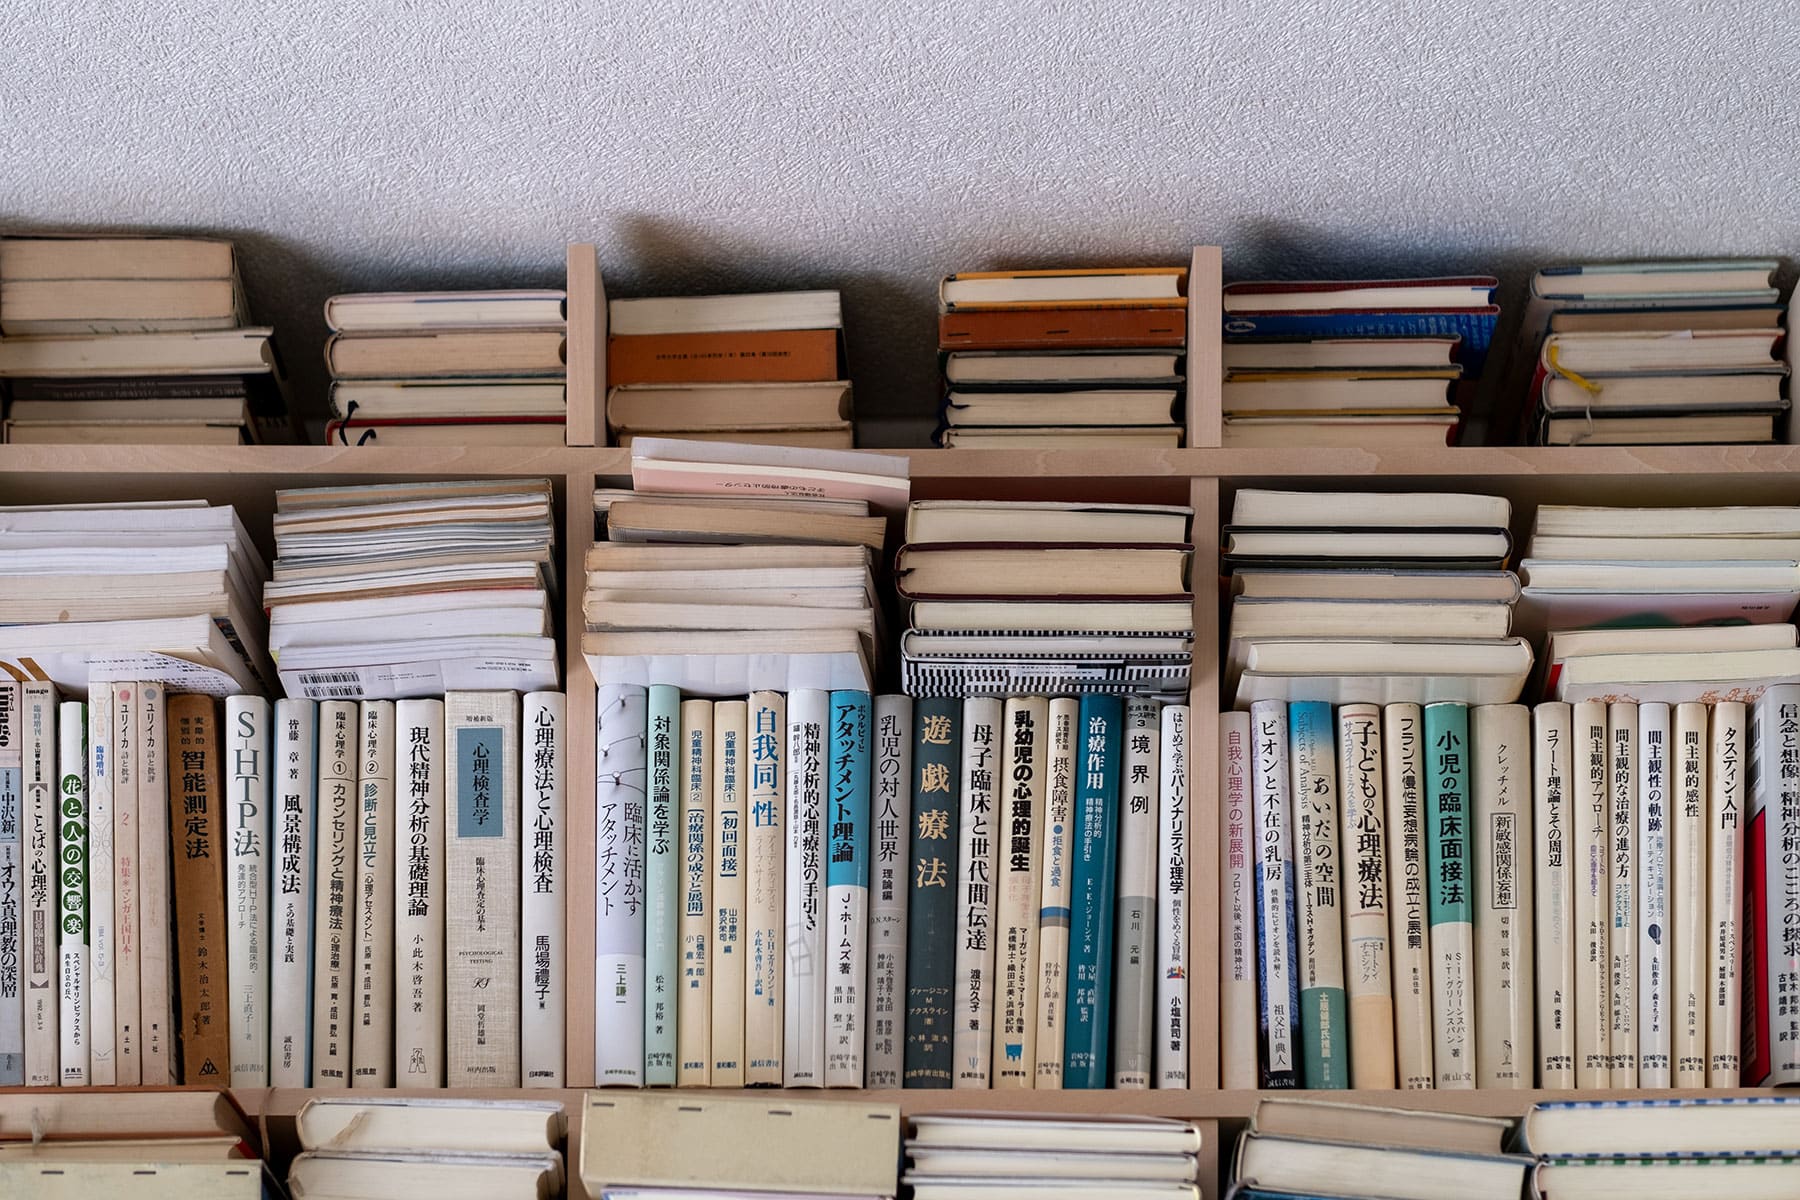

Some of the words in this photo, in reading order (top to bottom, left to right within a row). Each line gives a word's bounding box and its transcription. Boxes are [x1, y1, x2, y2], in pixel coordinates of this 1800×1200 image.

[96, 745, 104, 776] 臨時増刊
[121, 704, 129, 749] ユリイカ
[146, 704, 155, 747] ユリイカ
[289, 720, 299, 741] 皆藤
[289, 752, 299, 763] 章
[1087, 717, 1107, 790] 治療作用
[1300, 754, 1310, 766] of
[147, 751, 155, 783] 詩と批評
[234, 711, 260, 856] S-HTP法
[289, 769, 299, 780] 著
[473, 742, 489, 825] 心理検査学
[533, 706, 554, 893] 心理療法と心理検査
[652, 716, 671, 854] 対象関係論を学ぶ
[752, 707, 778, 828] 自我同一性
[832, 705, 855, 862] アタッチメント理論
[878, 714, 901, 862] 乳児の対人世界
[917, 716, 952, 888] 遊戯療法
[1010, 710, 1034, 872] 乳幼児の心理的誕生
[1051, 757, 1069, 822] 摂食障害
[1130, 735, 1150, 814] 境界例
[1170, 712, 1184, 894] はじめて学ぶパーソナリティ心理学
[1228, 731, 1243, 869] 自我心理学の新展開
[1262, 720, 1282, 880] ビオンと不在の乳房
[1300, 767, 1311, 810] Analysis
[1497, 744, 1509, 806] クレッチメル
[1548, 730, 1562, 867] コフート理論とその周辺
[1590, 726, 1603, 838] 間主観的アプローチ
[1615, 729, 1630, 878] 間主観的な治療の進め方
[1648, 731, 1662, 831] 間主観性の軌跡
[1685, 731, 1699, 817] 間主観的感性
[1721, 728, 1737, 829] タスティン入門
[1, 792, 15, 839] 中沢新一
[182, 751, 209, 859] 智能測定法
[364, 783, 378, 867] 診断と見立て
[408, 727, 430, 916] 現代精神分析の基礎理論
[803, 723, 821, 931] 精神分析的心理療法の手引き
[966, 724, 993, 951] 母子臨床と世代間伝達
[1084, 798, 1094, 861] 精神療法の手引き
[1094, 798, 1103, 838] 精神分析的
[1312, 774, 1334, 907] 「あいだ」の空間
[1352, 720, 1383, 909] 子どもの心理療法
[1401, 718, 1421, 949] フランス慢性妄想病論の成立と展開
[1437, 731, 1464, 905] 小児の臨床面接法
[31, 805, 46, 907] ことばの心理学
[64, 777, 82, 933] 花と人の交響楽
[282, 795, 302, 894] 風景構成法
[329, 784, 345, 930] カウンセリングと精神療法
[601, 804, 618, 916] アタッチメント
[623, 802, 642, 916] 臨床に活かす
[1051, 836, 1063, 887] 拒食と過食
[1302, 815, 1313, 888] 精神分析の第三主体
[1495, 816, 1512, 905] 新敏感関係妄想
[476, 857, 485, 932] 臨床心理査定の基本
[882, 869, 893, 901] 理論編
[1131, 910, 1141, 930] 石川
[1, 863, 17, 998] オウム真理教の深層
[284, 904, 294, 963] その基礎と実践
[719, 909, 727, 941] 野沢栄司
[729, 909, 737, 941] 山中康裕
[1172, 900, 1181, 962] 個性をめぐる冒険
[1232, 873, 1242, 981] フロイト以後、米国の精神分析
[1271, 889, 1280, 979] 情動的にビオンを読み解く
[616, 964, 626, 1003] 三上謙一
[656, 975, 664, 992] 松木
[656, 1003, 664, 1020] 邦裕
[834, 986, 842, 1003] 黒田
[846, 986, 855, 1004] 黒田
[970, 969, 981, 1013] 渡辺久子
[1016, 928, 1027, 1033] マーガレット・S・マーラー他著
[1688, 993, 1695, 1006] 丸田
[1778, 974, 1788, 992] 古賀
[1789, 973, 1798, 992] 松木
[283, 1036, 292, 1068] 誠信書房
[970, 1019, 979, 1030] 著
[1170, 996, 1181, 1039] 小塩真司
[1170, 1041, 1180, 1051] 著
[1452, 1049, 1460, 1057] 著
[1779, 1032, 1788, 1041] 訳
[321, 1069, 343, 1077] 培風館
[751, 1060, 778, 1068] 誠信書房
[1268, 1079, 1295, 1087] 誠信書房
